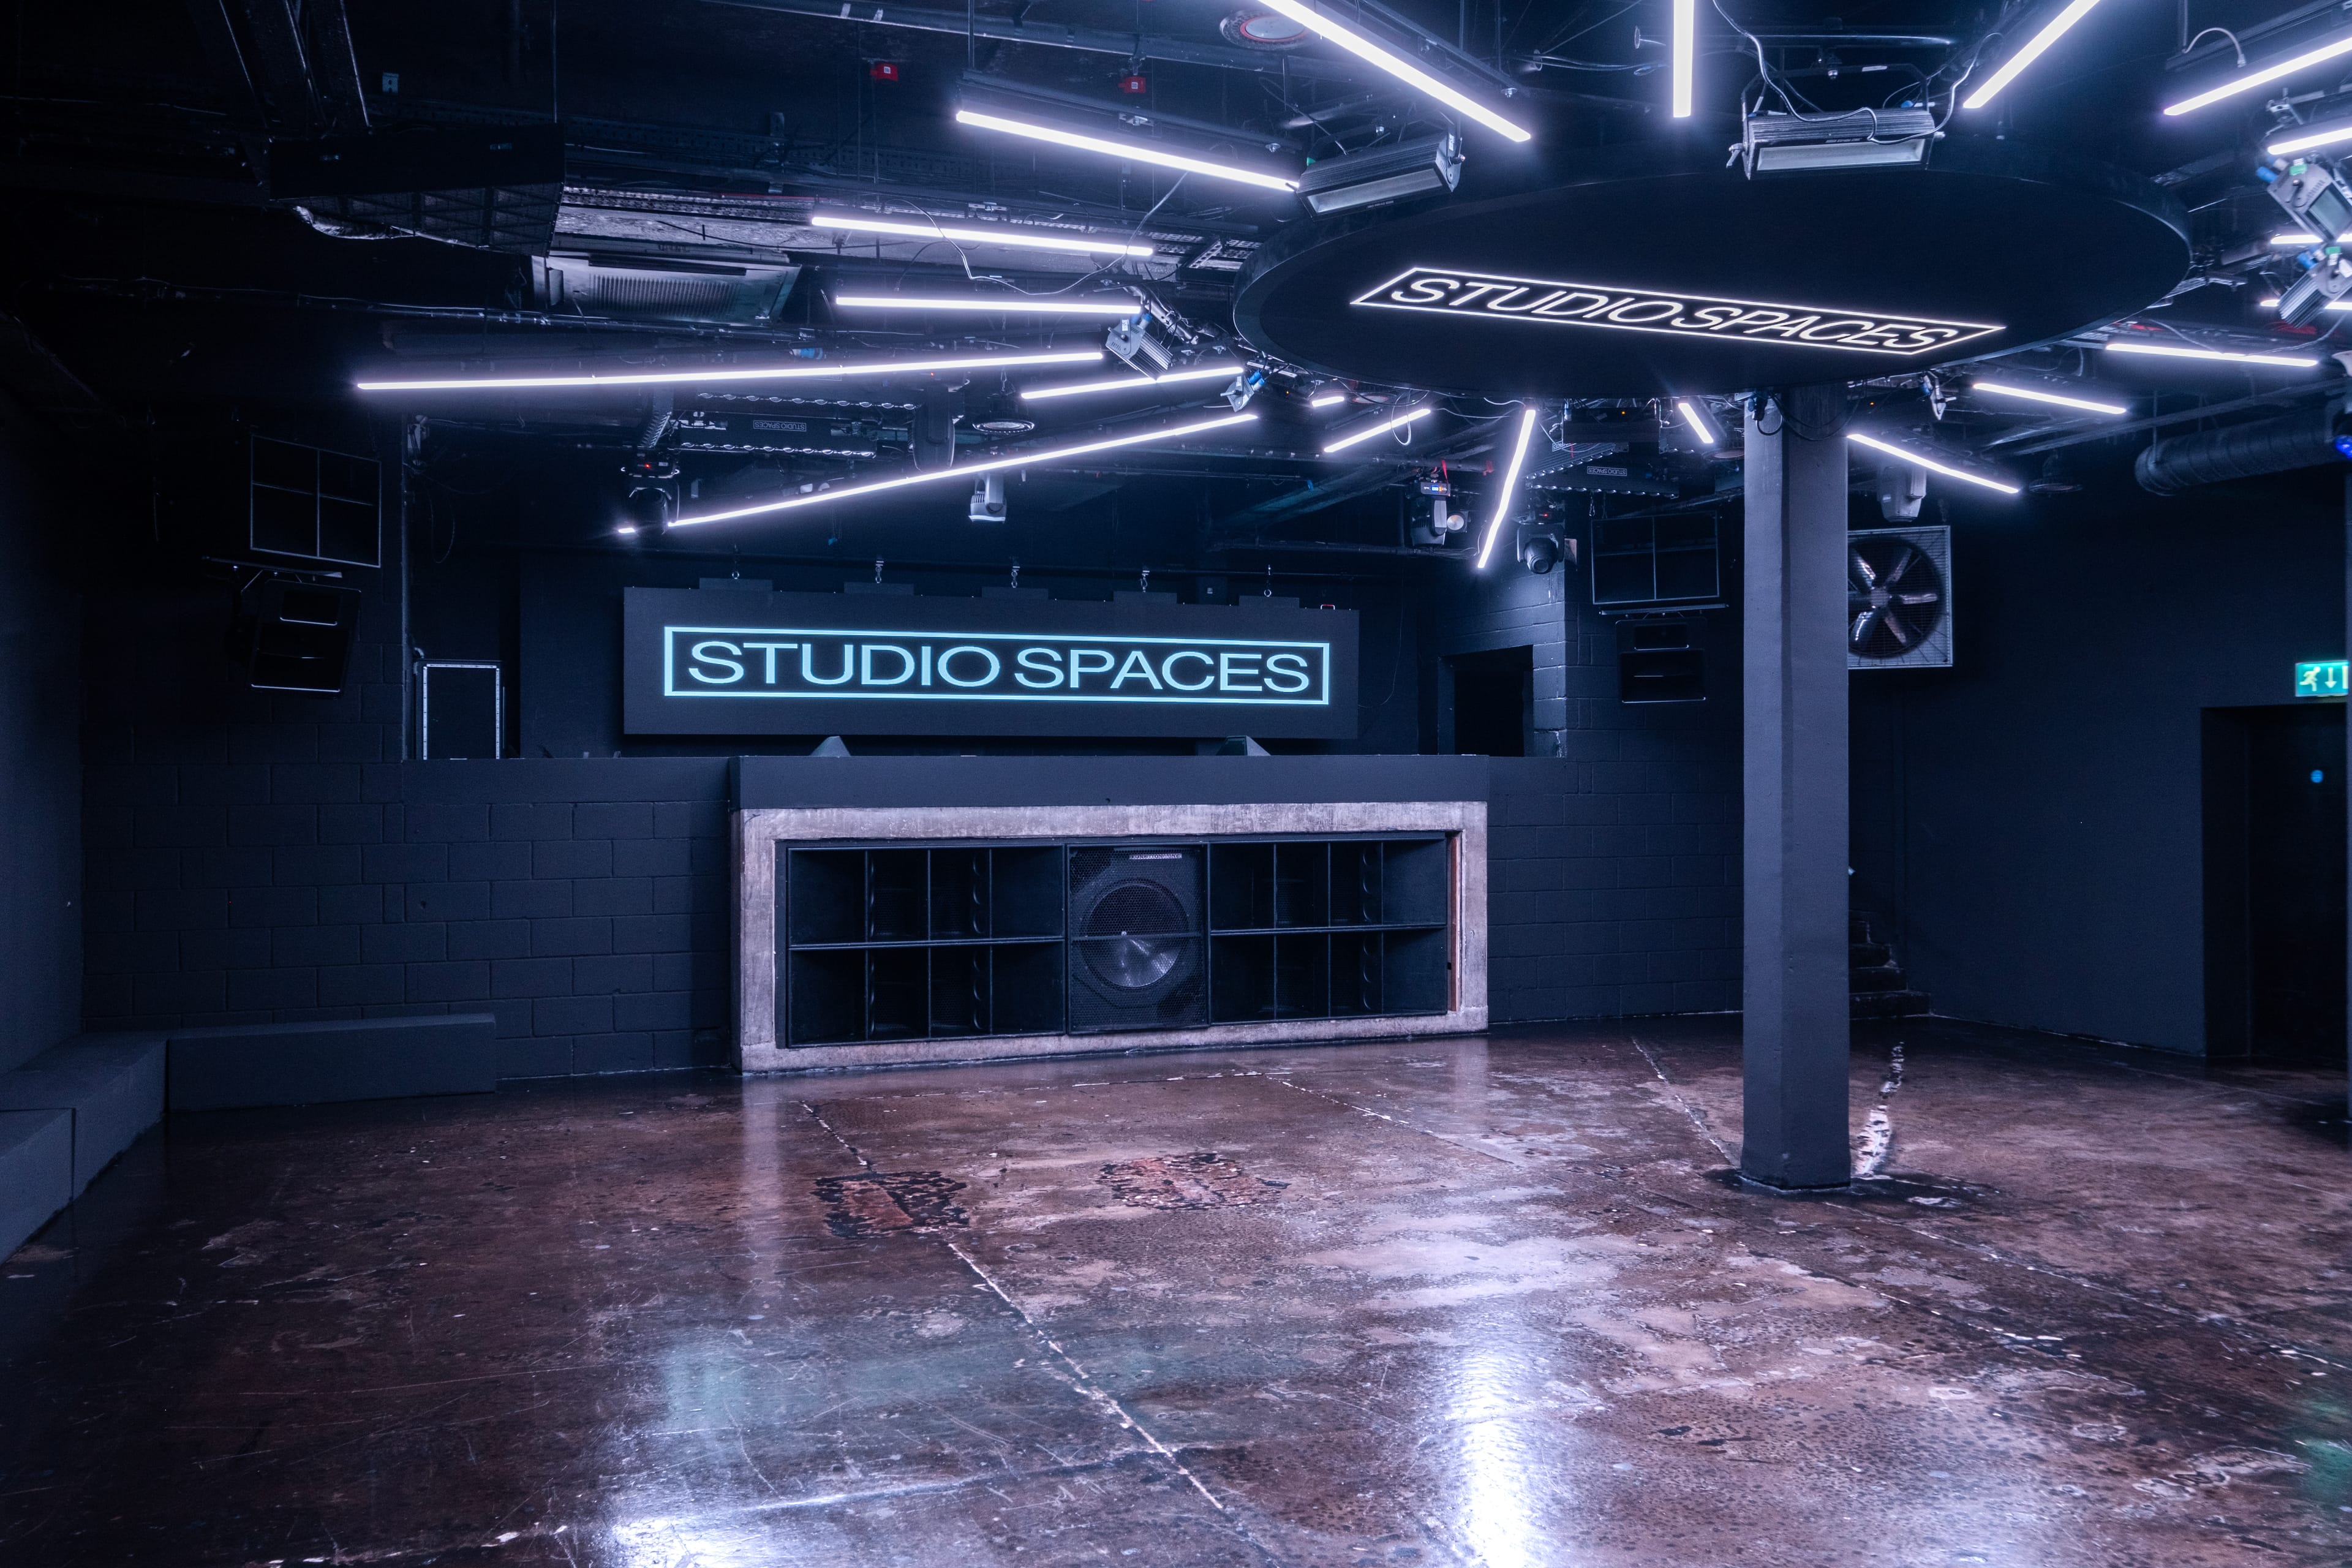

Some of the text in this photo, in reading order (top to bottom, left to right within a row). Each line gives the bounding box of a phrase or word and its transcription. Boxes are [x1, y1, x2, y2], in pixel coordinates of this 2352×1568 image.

[1390, 277, 1959, 349] STUDIO SPACES
[688, 640, 1310, 693] STUDIO SPACES
